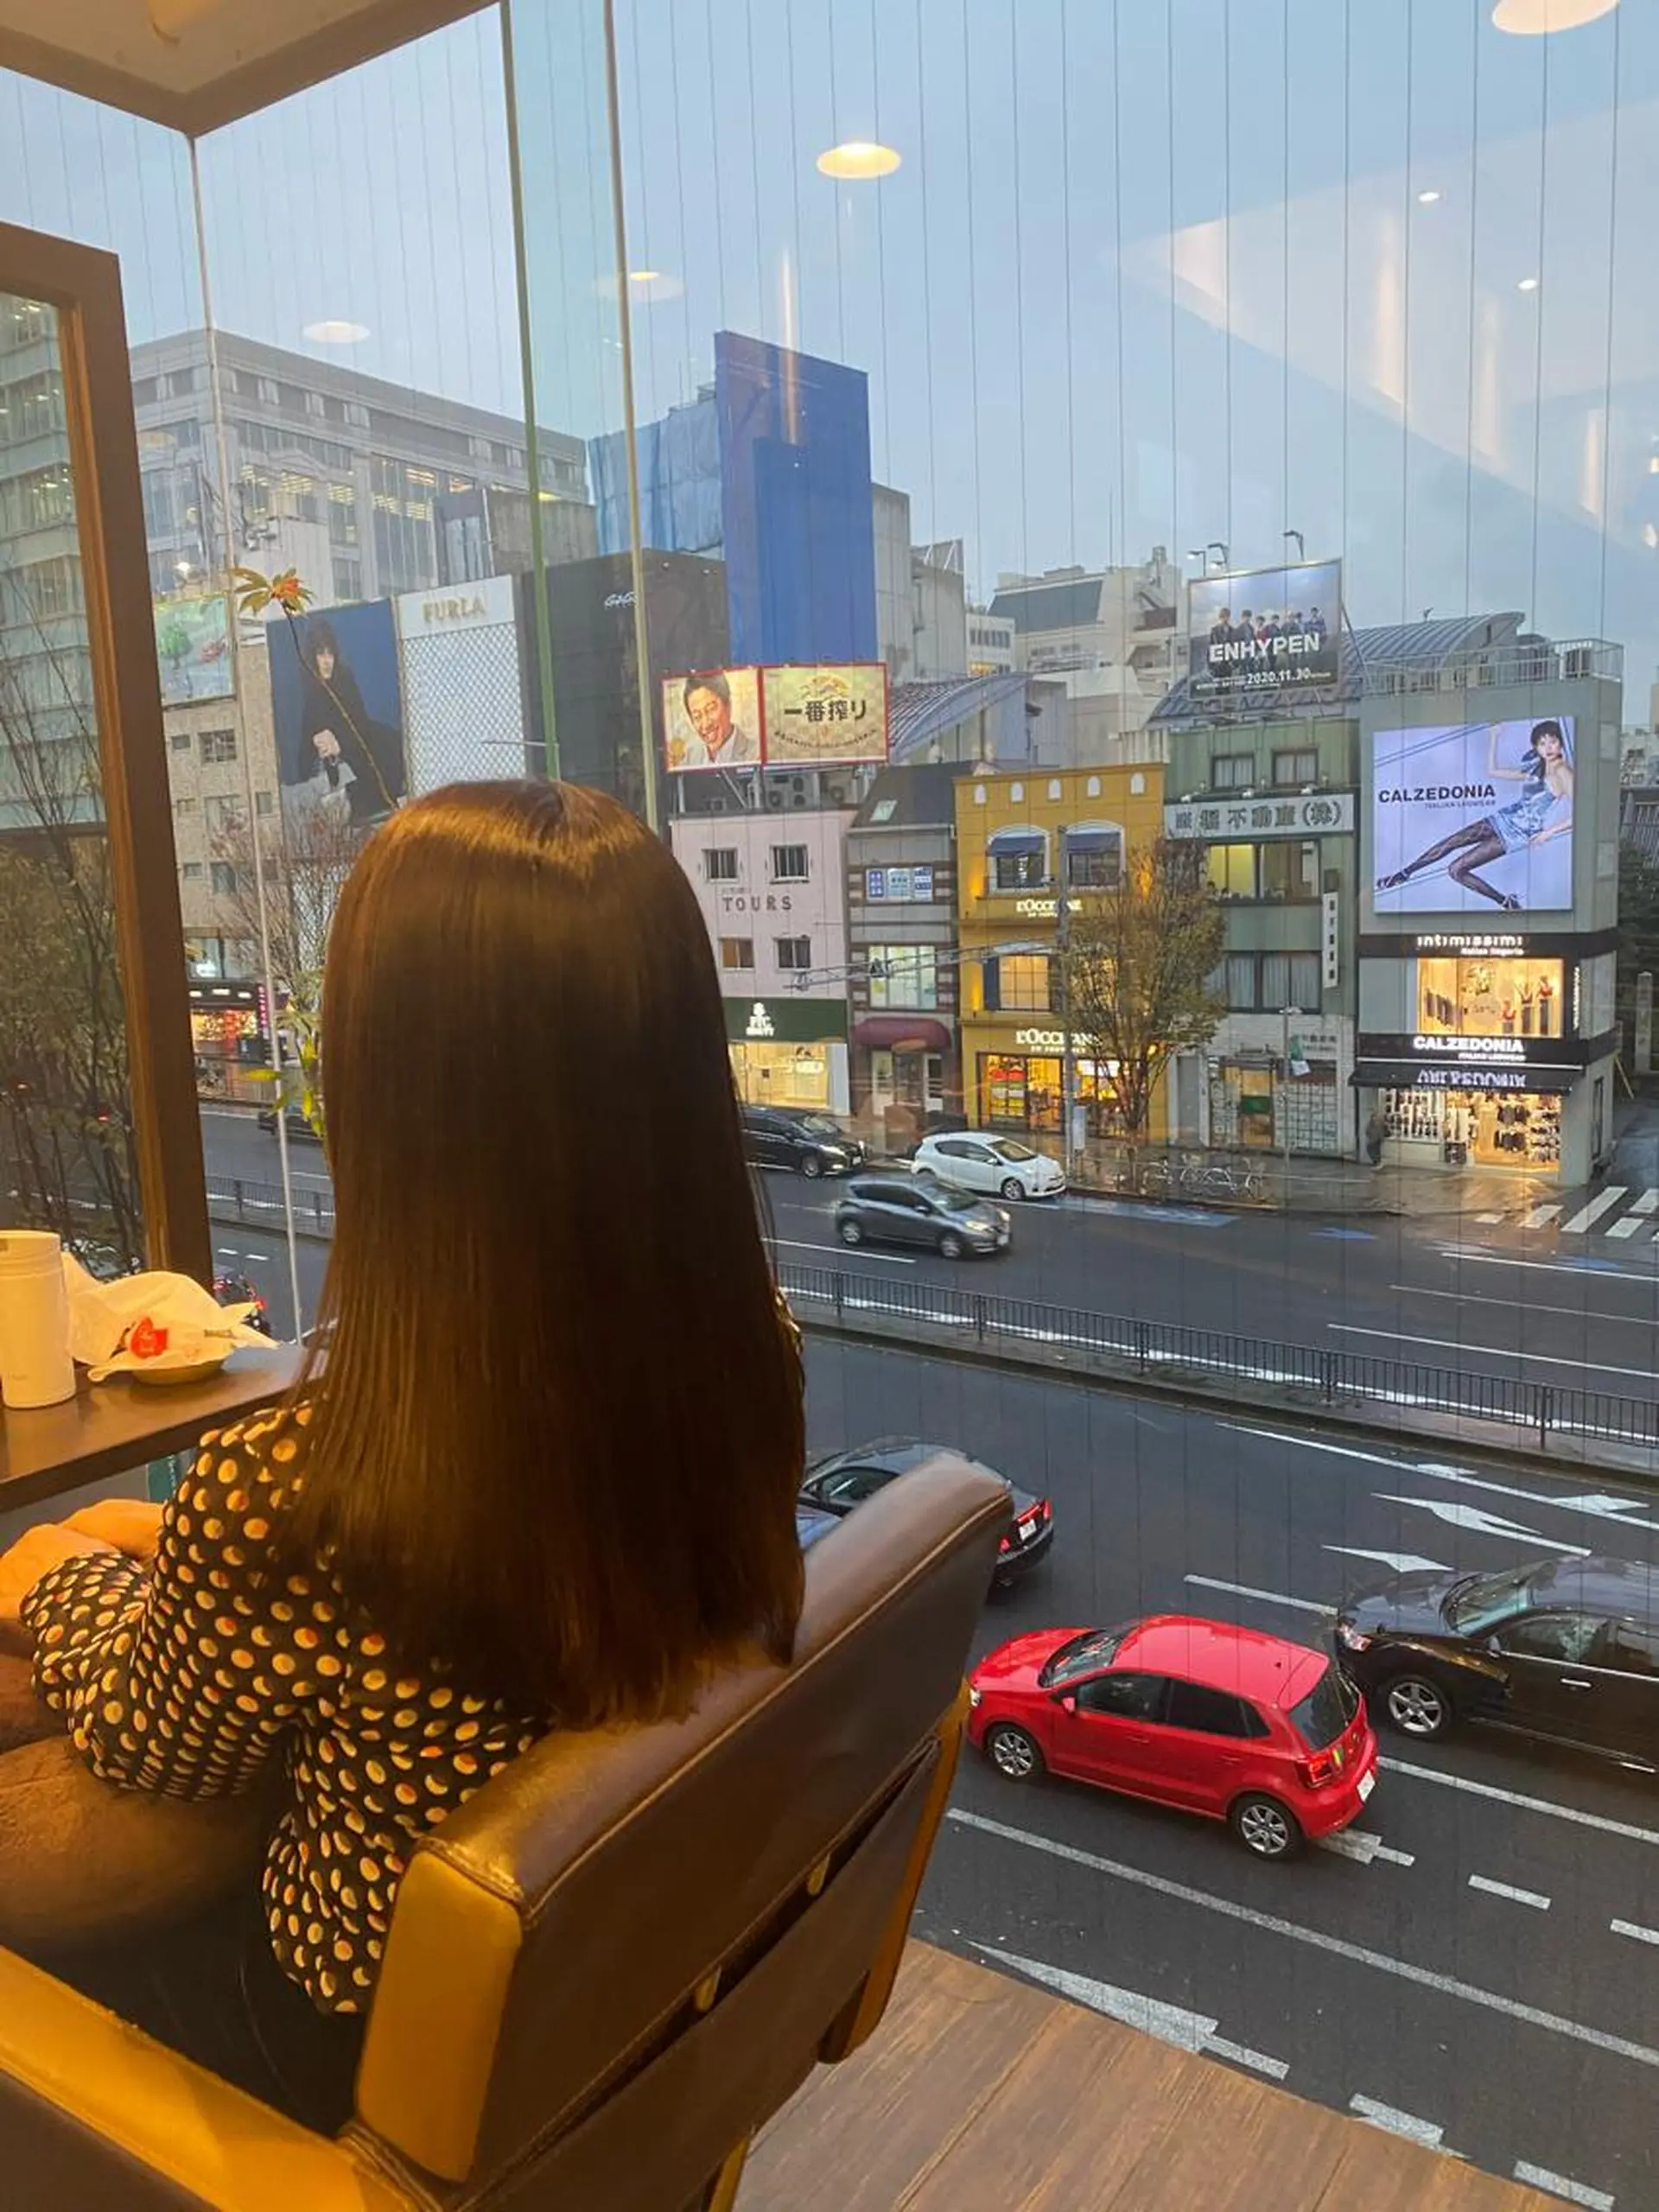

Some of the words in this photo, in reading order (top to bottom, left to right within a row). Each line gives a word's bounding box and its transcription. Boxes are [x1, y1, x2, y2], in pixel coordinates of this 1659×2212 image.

[422, 596, 486, 622] FURLA
[1210, 632, 1319, 663] ENHYPEN
[1247, 667, 1312, 685] 2020.11.30
[784, 699, 867, 722] 一番搾り
[1378, 785, 1496, 803] CALZEDONIA
[722, 895, 792, 912] TOURS
[1417, 934, 1523, 947] intimissimi
[1413, 1037, 1524, 1052] CALZEDONIA
